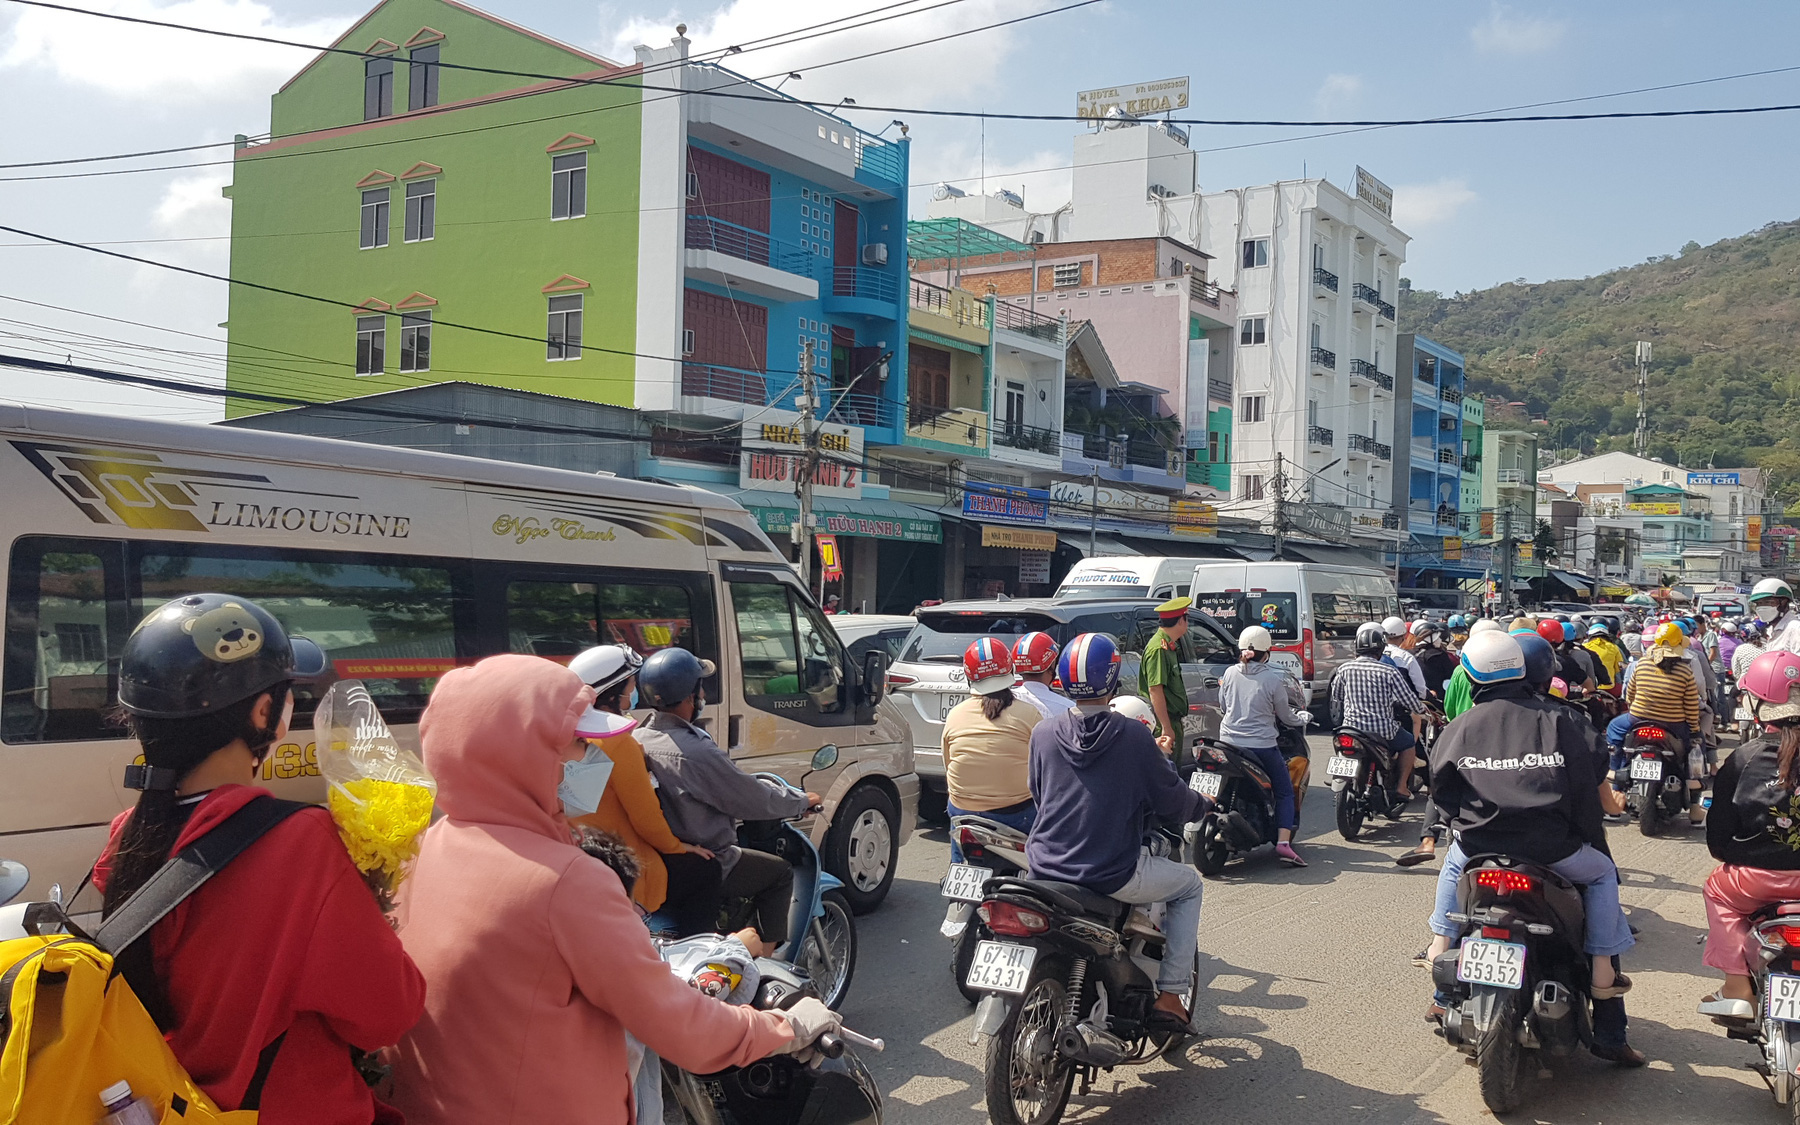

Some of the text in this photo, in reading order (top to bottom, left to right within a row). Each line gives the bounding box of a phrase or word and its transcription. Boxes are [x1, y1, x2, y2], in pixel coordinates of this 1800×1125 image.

[1090, 88, 1119, 101] HOTEL
[1126, 95, 1172, 114] KHOA
[1177, 93, 1187, 108] 2
[844, 466, 857, 489] 2
[1689, 477, 1736, 485] KIM CHI
[969, 495, 1007, 514] THANH
[1009, 499, 1044, 518] PHONG
[208, 500, 412, 539] LIMOUSINE
[492, 514, 617, 545] Ngọc Thanh
[828, 514, 857, 532] HỮU
[858, 519, 893, 538] HẠNH
[894, 522, 903, 537] 2
[773, 699, 808, 709] TRANSIT
[1333, 758, 1354, 767] 67-E1
[1636, 761, 1657, 771] 67-H1
[1196, 774, 1216, 786] 67-G1
[954, 866, 985, 884] 67-D1
[945, 879, 983, 899] 487.13
[982, 945, 1025, 968] 67-H1
[1470, 942, 1516, 965] 67-L2
[971, 964, 1025, 989] 543.31
[1463, 960, 1518, 985] 553.52
[1774, 997, 1800, 1019] 71
